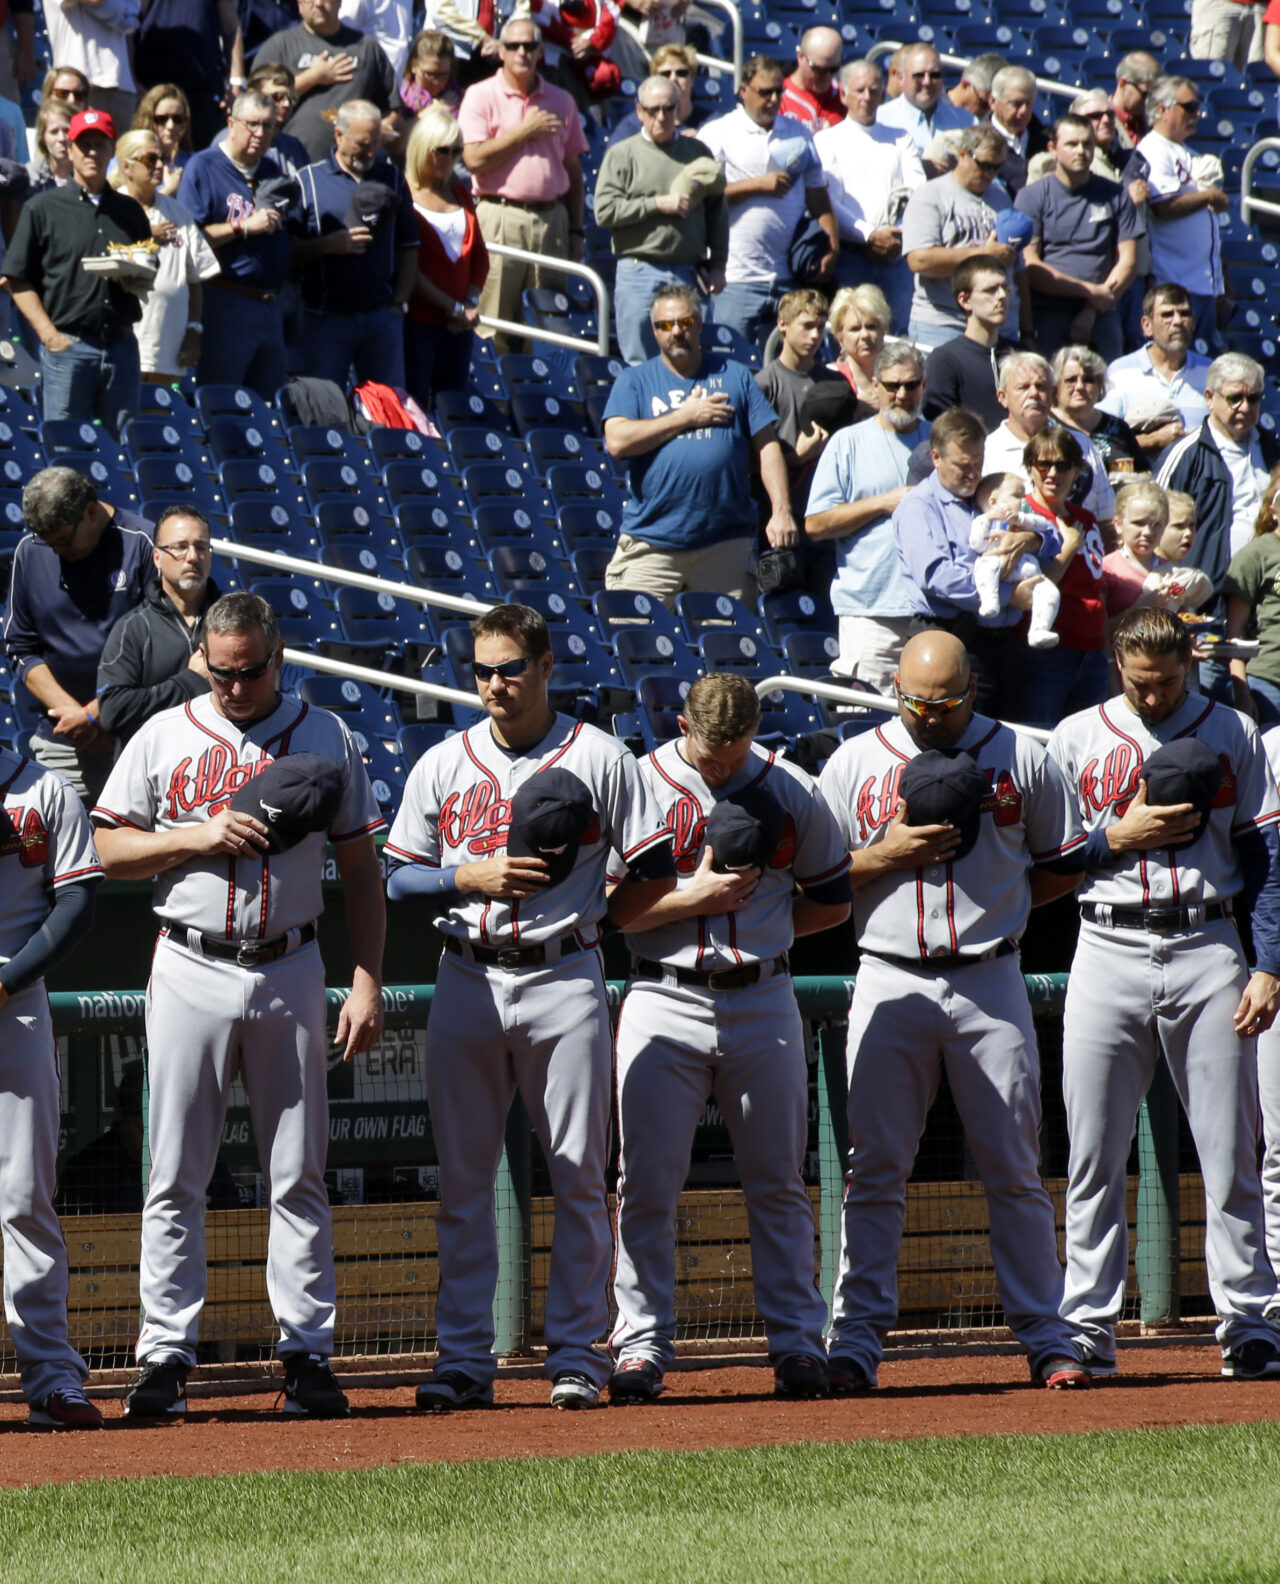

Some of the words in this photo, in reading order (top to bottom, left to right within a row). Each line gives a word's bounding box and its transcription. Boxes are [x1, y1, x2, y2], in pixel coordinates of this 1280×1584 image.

[1081, 744, 1142, 819] Atla
[438, 780, 514, 857] Atla
[366, 1044, 416, 1076] ERA
[223, 1121, 249, 1144] LAG
[354, 1117, 388, 1139] OWN
[391, 1115, 426, 1138] FLAG
